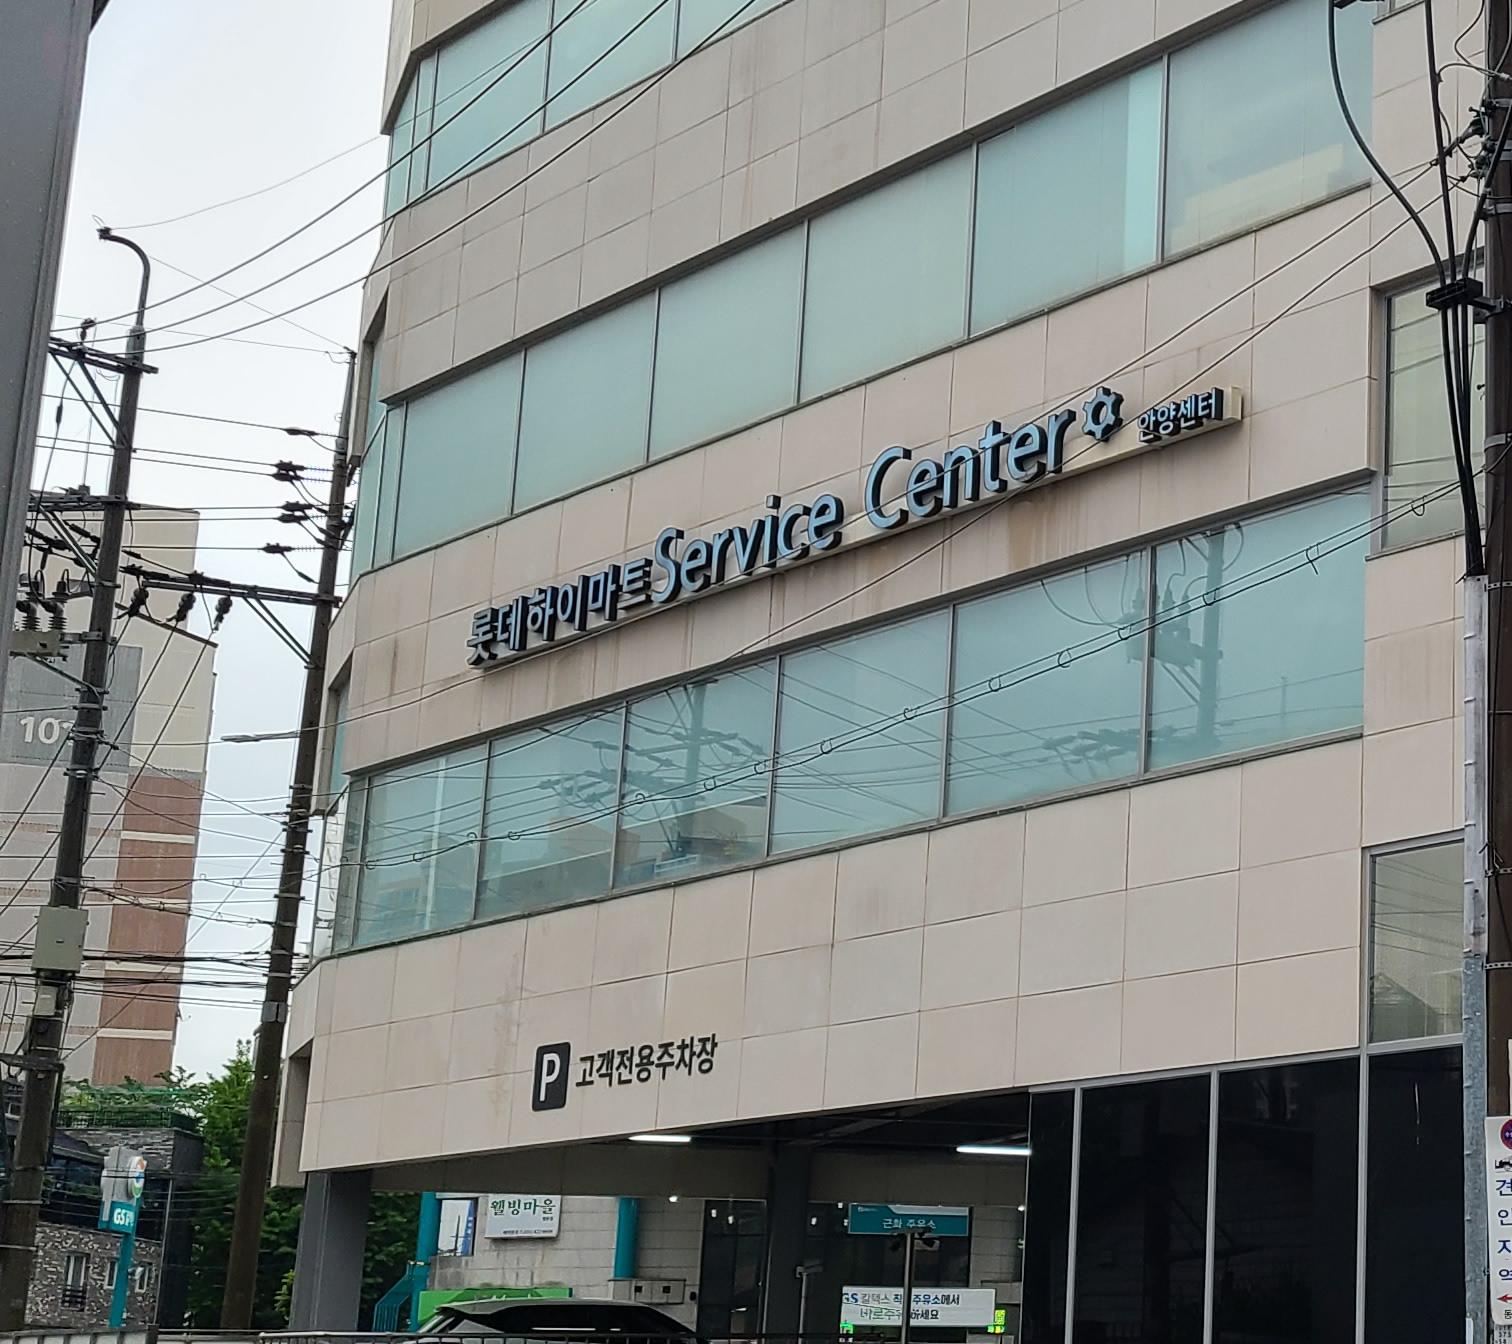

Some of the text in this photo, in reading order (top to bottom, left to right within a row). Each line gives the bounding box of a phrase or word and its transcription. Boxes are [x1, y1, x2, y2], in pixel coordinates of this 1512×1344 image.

[466, 387, 1224, 667] 롯데하이마트 Service Center 안양센터
[539, 1033, 719, 1103] P 고객전용주차장
